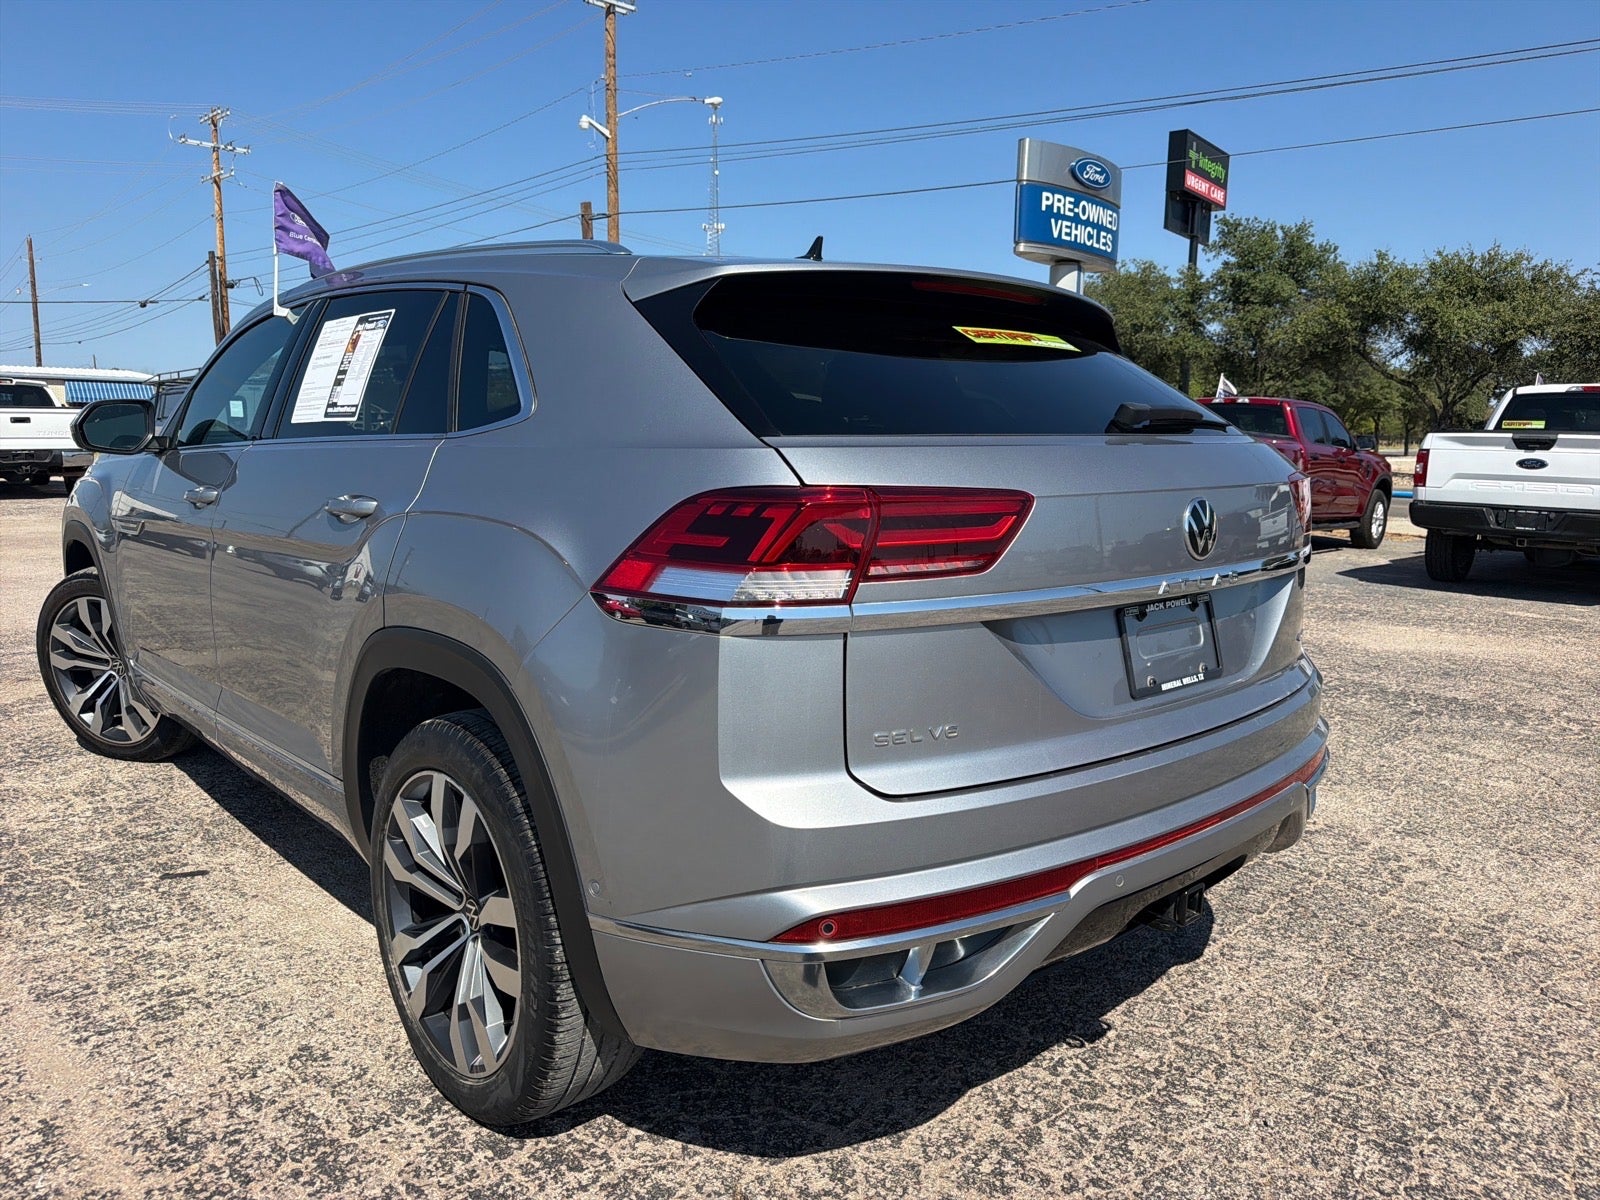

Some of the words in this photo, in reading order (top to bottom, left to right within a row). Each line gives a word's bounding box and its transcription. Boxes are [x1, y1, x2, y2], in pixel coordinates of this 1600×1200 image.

[1083, 164, 1106, 183] Ford
[1199, 152, 1226, 183] Integrity
[1186, 173, 1209, 195] URGENT
[1210, 186, 1225, 203] CARE
[1041, 191, 1118, 231] PRE-OWNED
[1050, 218, 1113, 253] VEHICLES
[1157, 571, 1239, 595] ATLAS
[1145, 602, 1165, 613] JACK
[1166, 597, 1192, 608] POWELL
[1161, 680, 1183, 691] MINERAL
[1182, 675, 1199, 685] WELLS,
[1197, 673, 1205, 681] TX
[873, 728, 923, 747] SEL
[928, 724, 959, 741] V6
